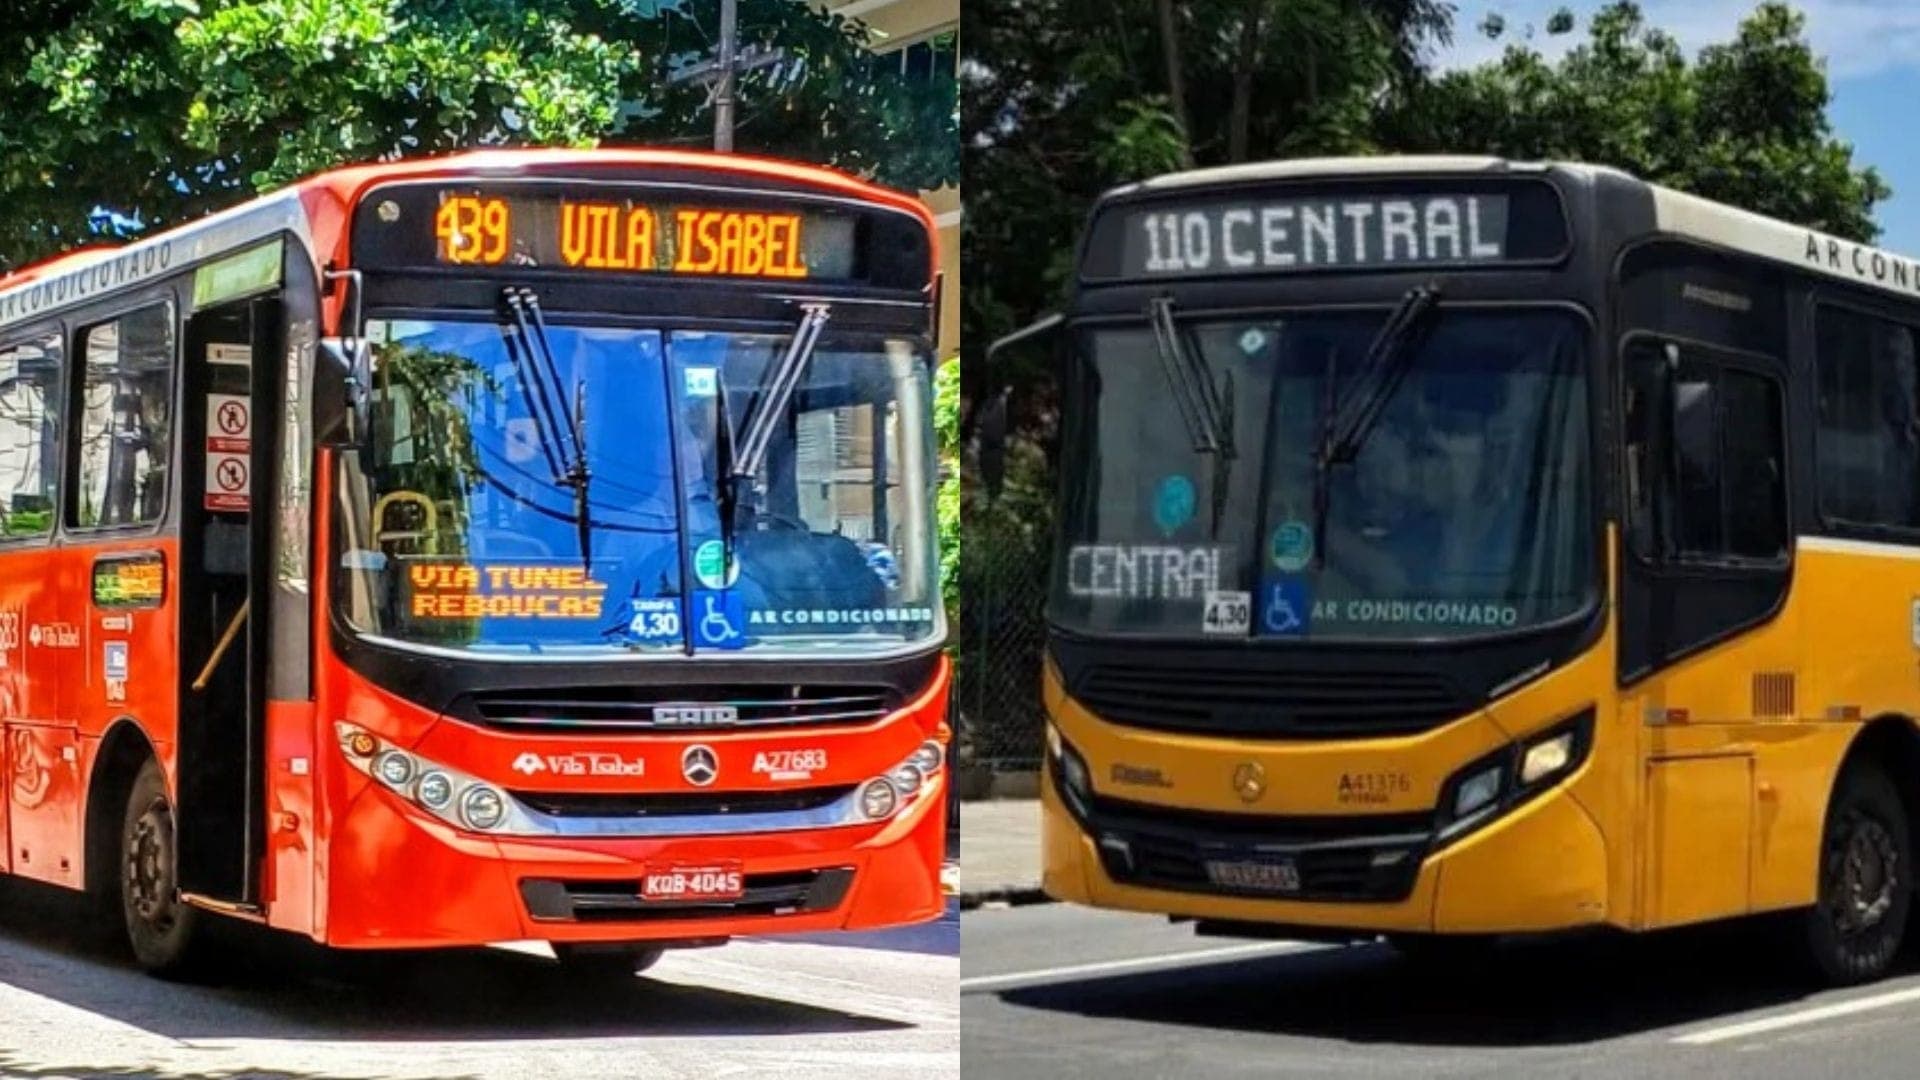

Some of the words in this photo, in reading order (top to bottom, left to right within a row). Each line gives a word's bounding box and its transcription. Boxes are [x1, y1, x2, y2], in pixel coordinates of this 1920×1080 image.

[436, 196, 509, 264] 439
[562, 203, 652, 269] VILA
[675, 210, 808, 277] ISABEL
[1144, 211, 1211, 271] 110
[1222, 197, 1499, 267] CENTRAL
[412, 565, 479, 588] VIA
[1069, 545, 1218, 598] CENTRAL
[414, 594, 604, 617] REBOUCAS
[750, 610, 778, 624] AR
[783, 607, 932, 624] CONDICIONADO
[1207, 603, 1247, 629] 4,30
[1311, 601, 1338, 620] AR
[1347, 600, 1517, 625] CONDICIONADO
[630, 612, 680, 638] 4,30
[546, 755, 587, 775] Vila
[589, 753, 645, 776] Isabel
[752, 748, 828, 774] A27683
